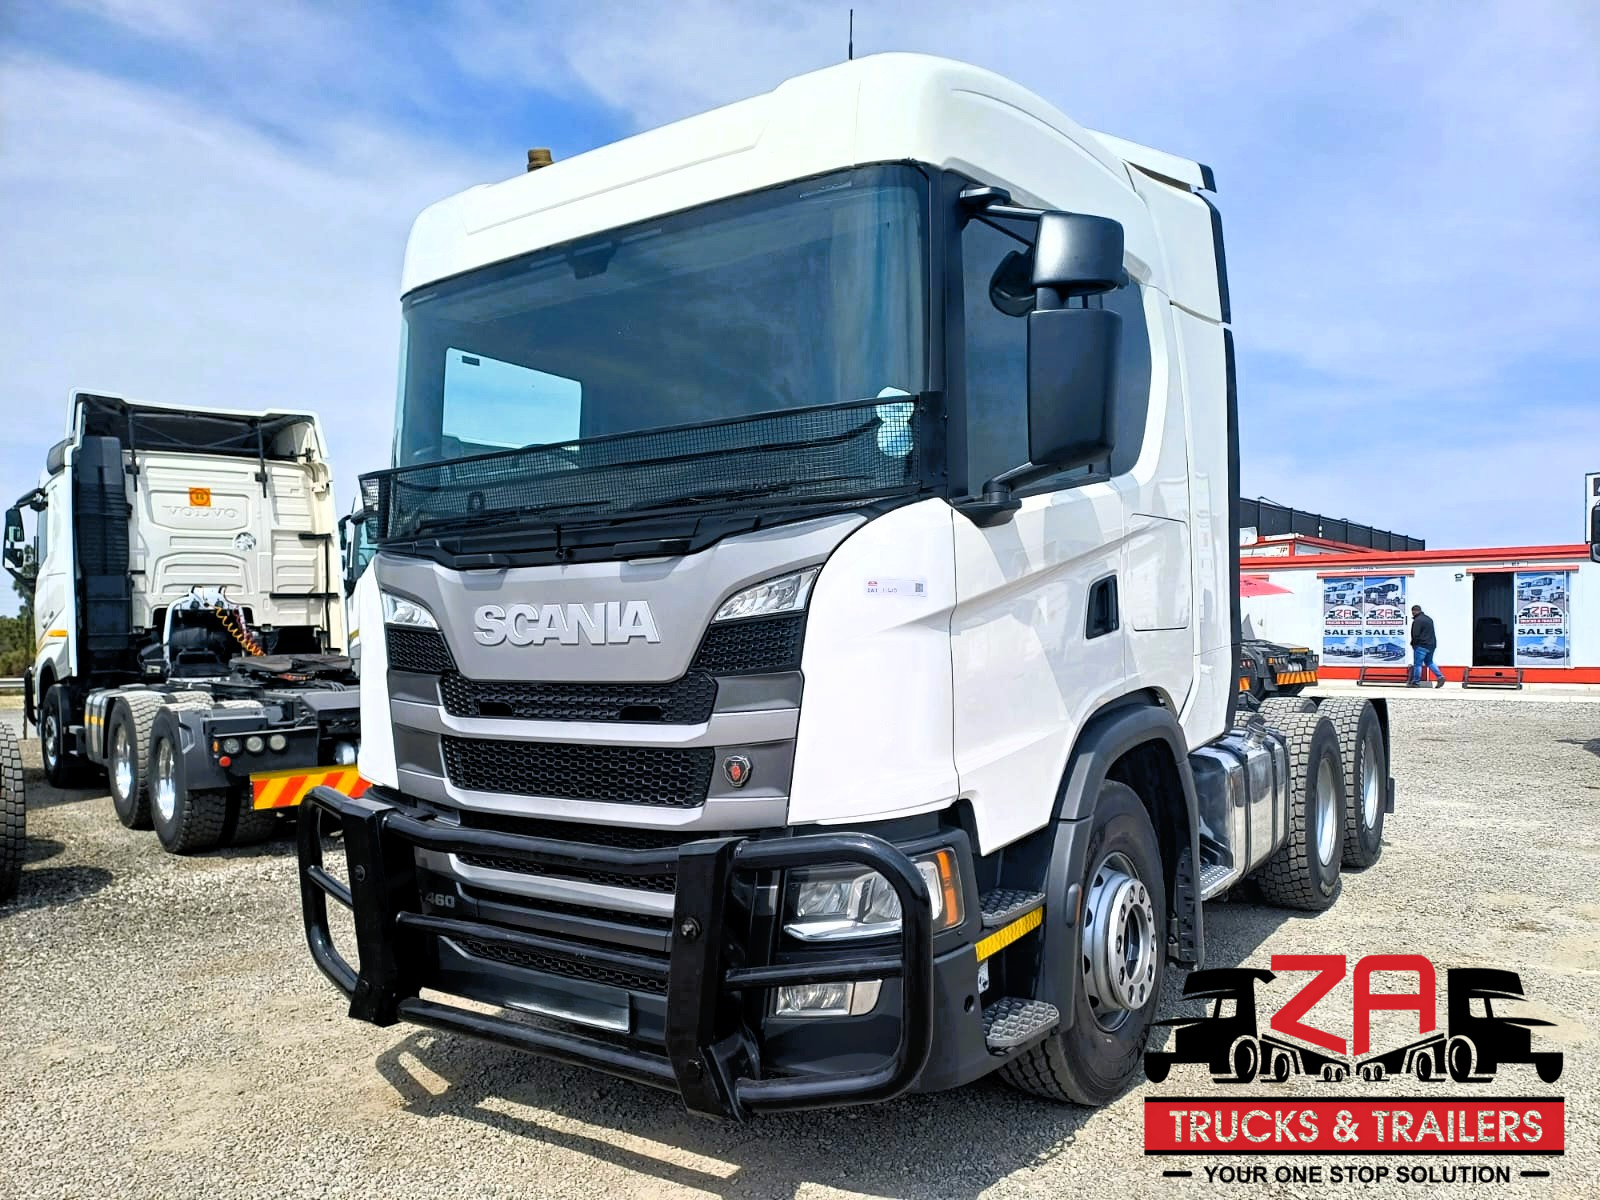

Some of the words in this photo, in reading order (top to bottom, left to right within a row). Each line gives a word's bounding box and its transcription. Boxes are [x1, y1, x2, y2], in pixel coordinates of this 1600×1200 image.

[162, 505, 238, 518] VOLVO
[473, 600, 661, 646] SCANIA
[425, 892, 455, 908] 460
